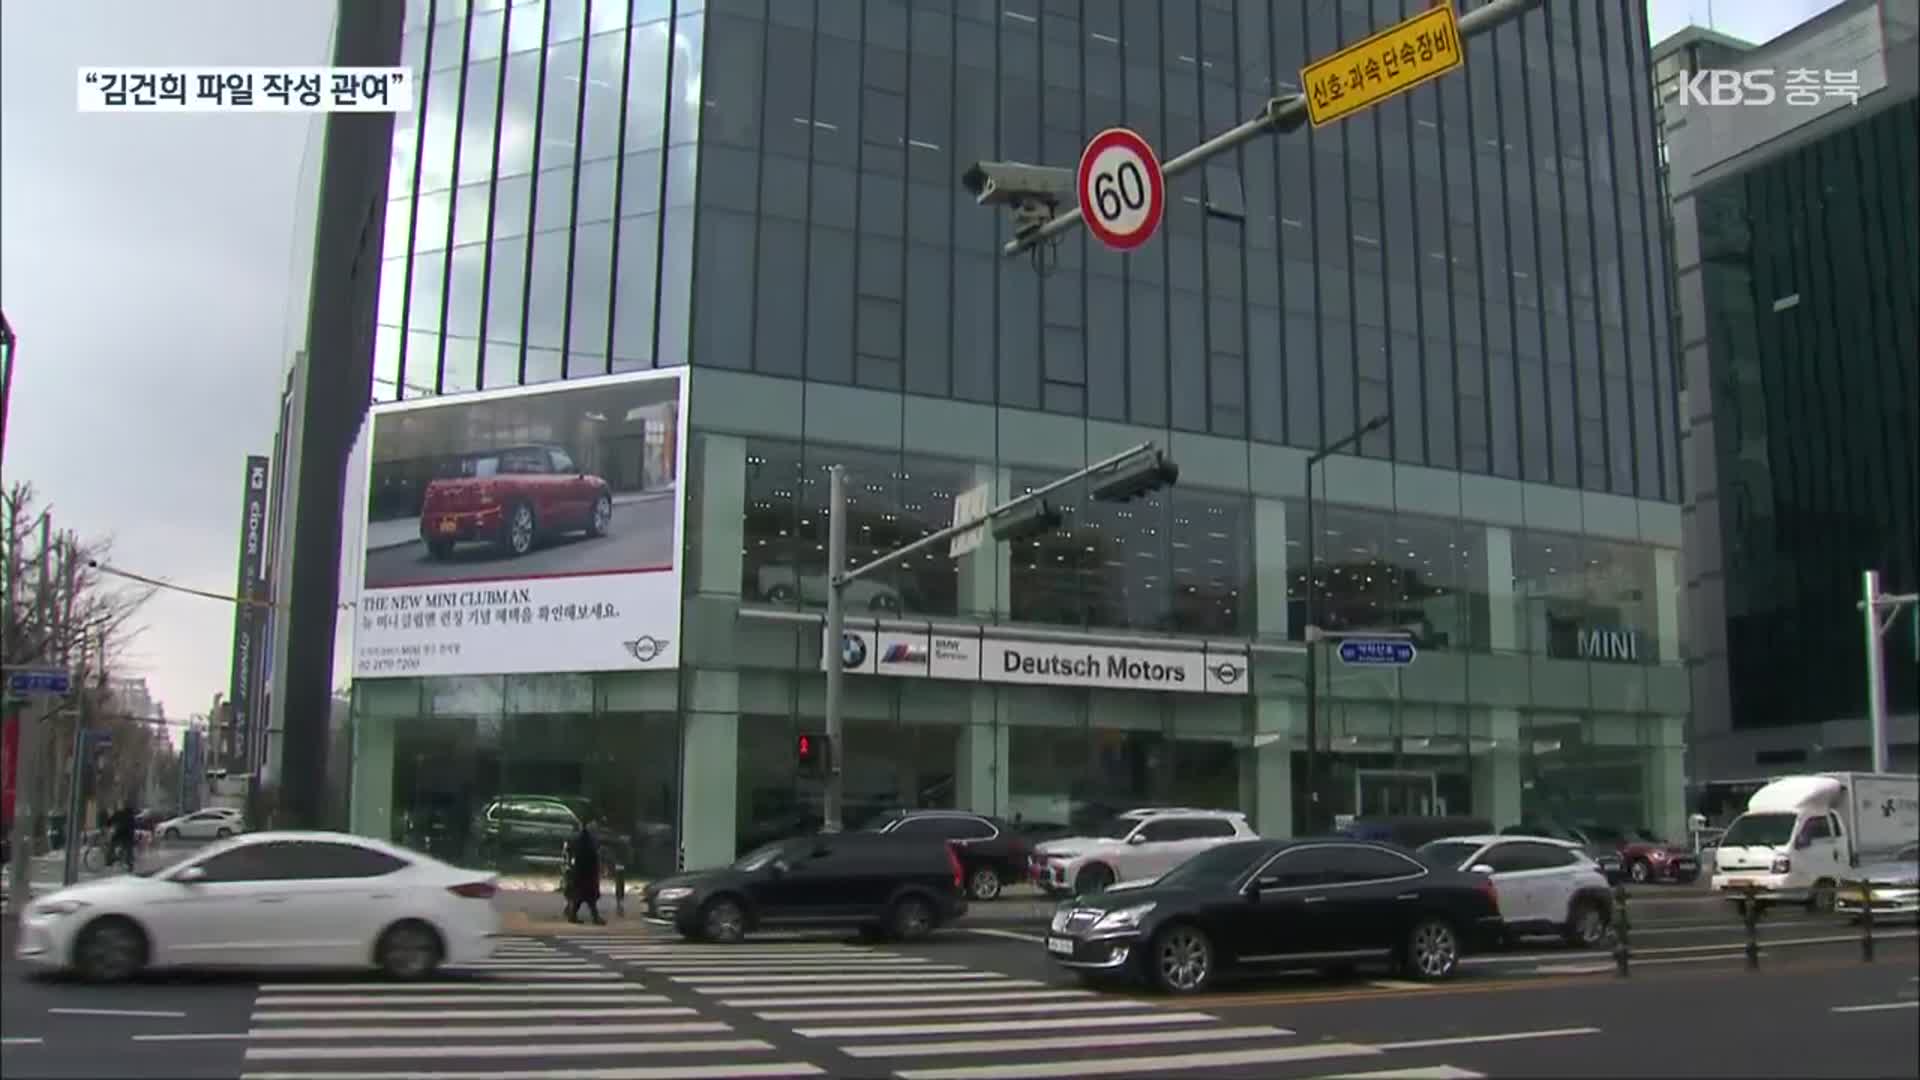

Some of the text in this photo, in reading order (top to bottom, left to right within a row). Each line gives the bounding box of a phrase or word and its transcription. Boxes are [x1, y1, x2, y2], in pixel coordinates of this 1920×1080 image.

[1095, 161, 1145, 221] 60
[252, 467, 264, 489] K2
[363, 597, 388, 611] THE
[390, 595, 421, 609] NEW
[424, 593, 456, 608] MINI
[467, 608, 491, 625] 기념
[1577, 630, 1637, 660] MINI
[1003, 650, 1186, 683] Deutsch Motors
